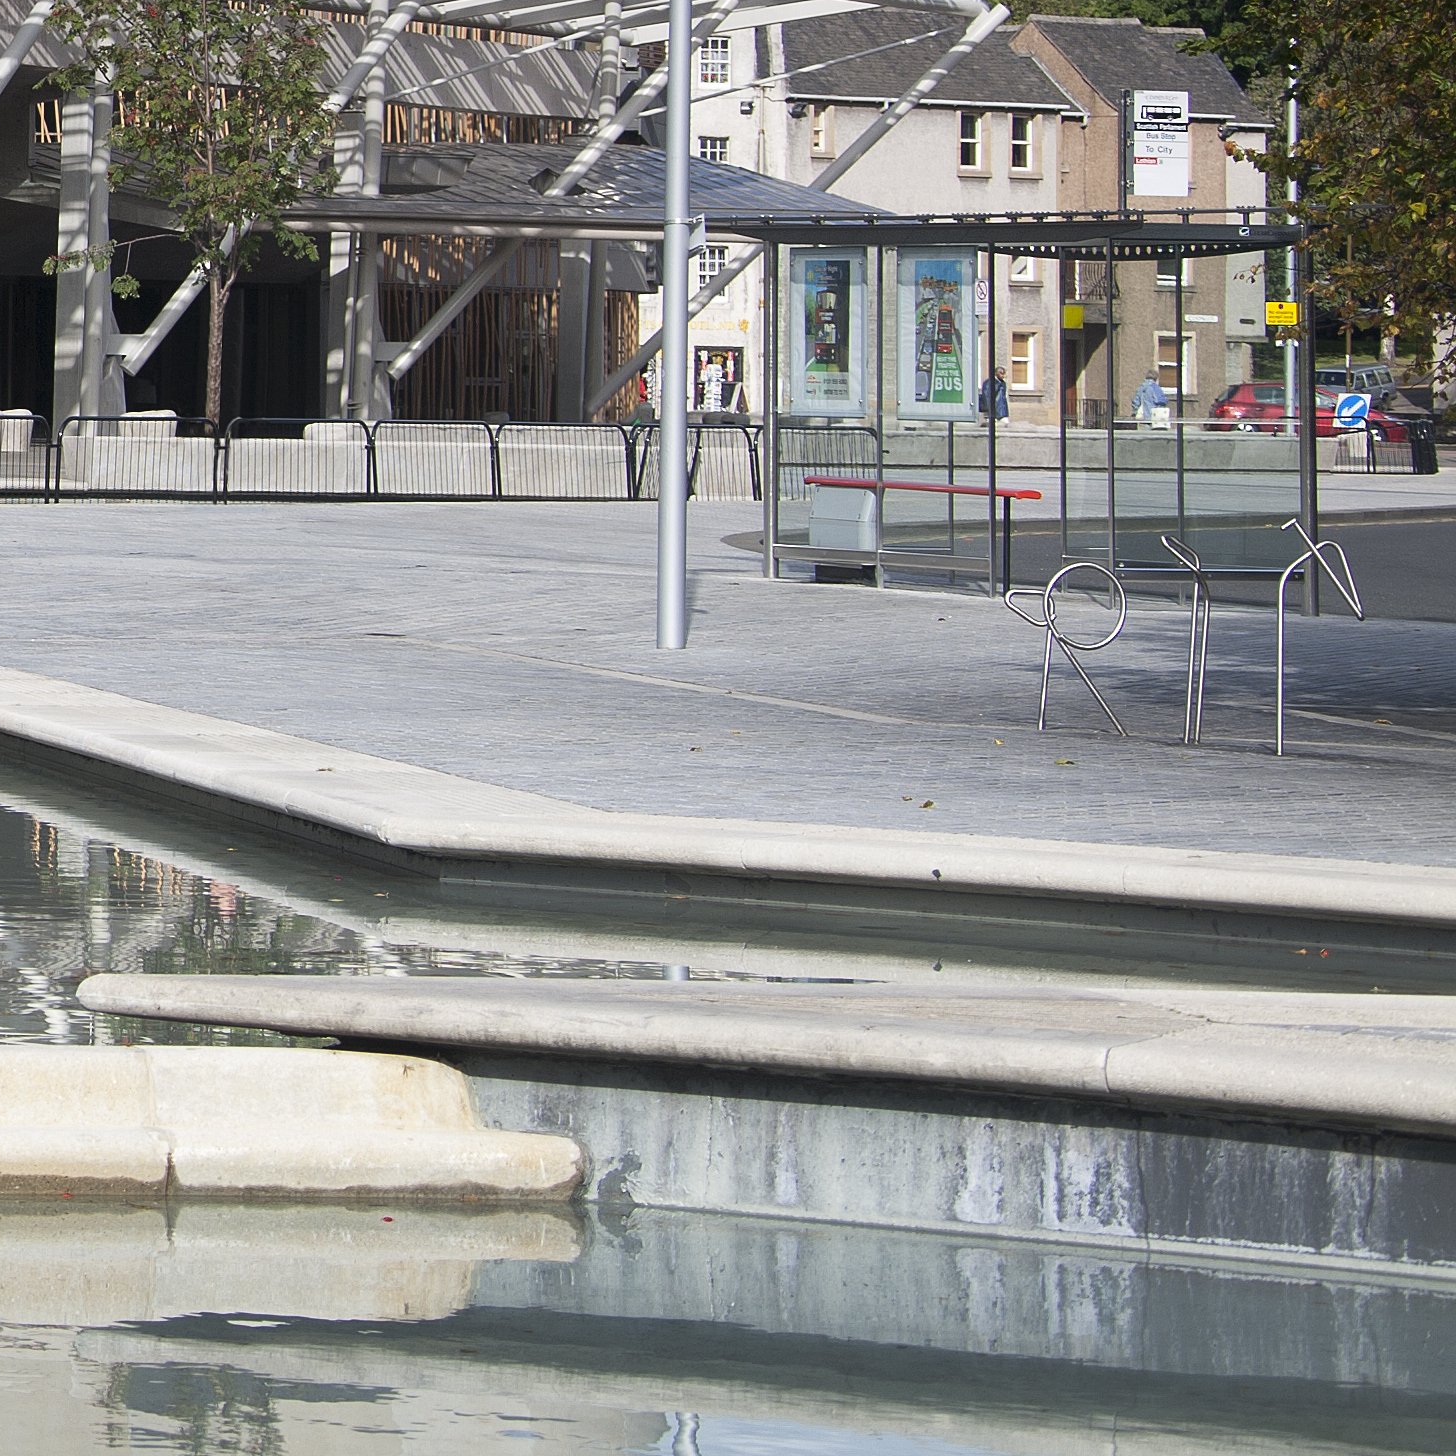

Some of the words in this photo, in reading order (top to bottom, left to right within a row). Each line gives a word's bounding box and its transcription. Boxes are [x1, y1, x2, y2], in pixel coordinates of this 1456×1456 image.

[1161, 132, 1176, 141] Stop
[1158, 146, 1172, 154] City
[935, 377, 963, 391] BUS
